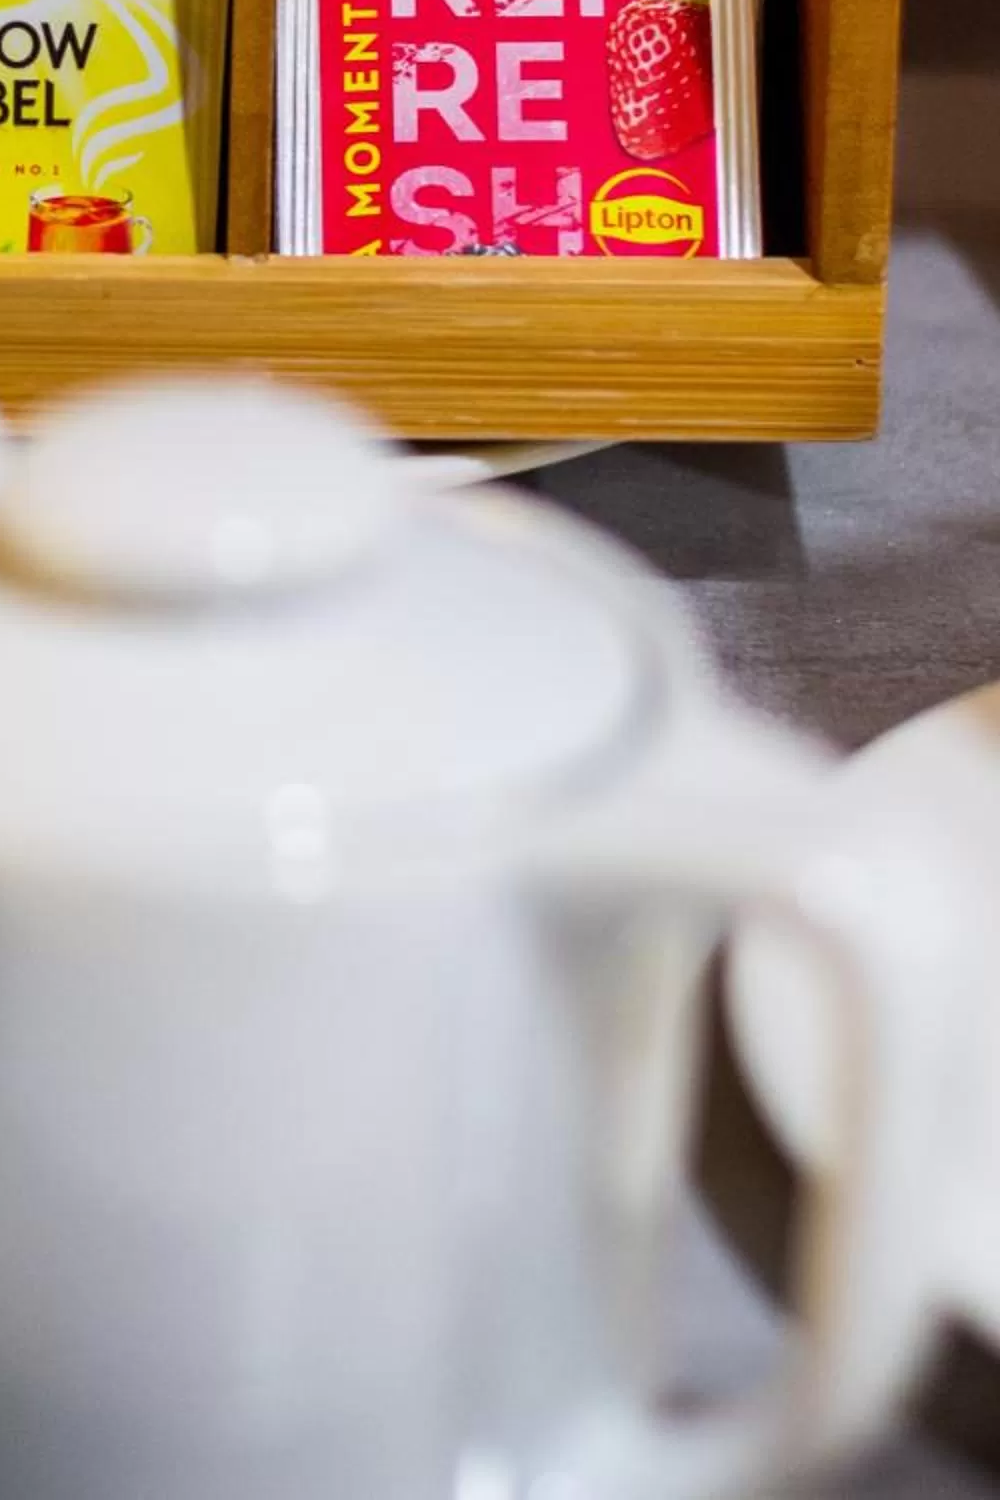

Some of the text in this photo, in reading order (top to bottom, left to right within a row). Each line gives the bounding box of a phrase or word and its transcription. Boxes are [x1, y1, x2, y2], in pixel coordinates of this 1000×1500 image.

[342, 3, 382, 217] MOMENT
[390, 40, 569, 143] RE
[389, 165, 583, 257] SH
[600, 206, 694, 233] Lipton
